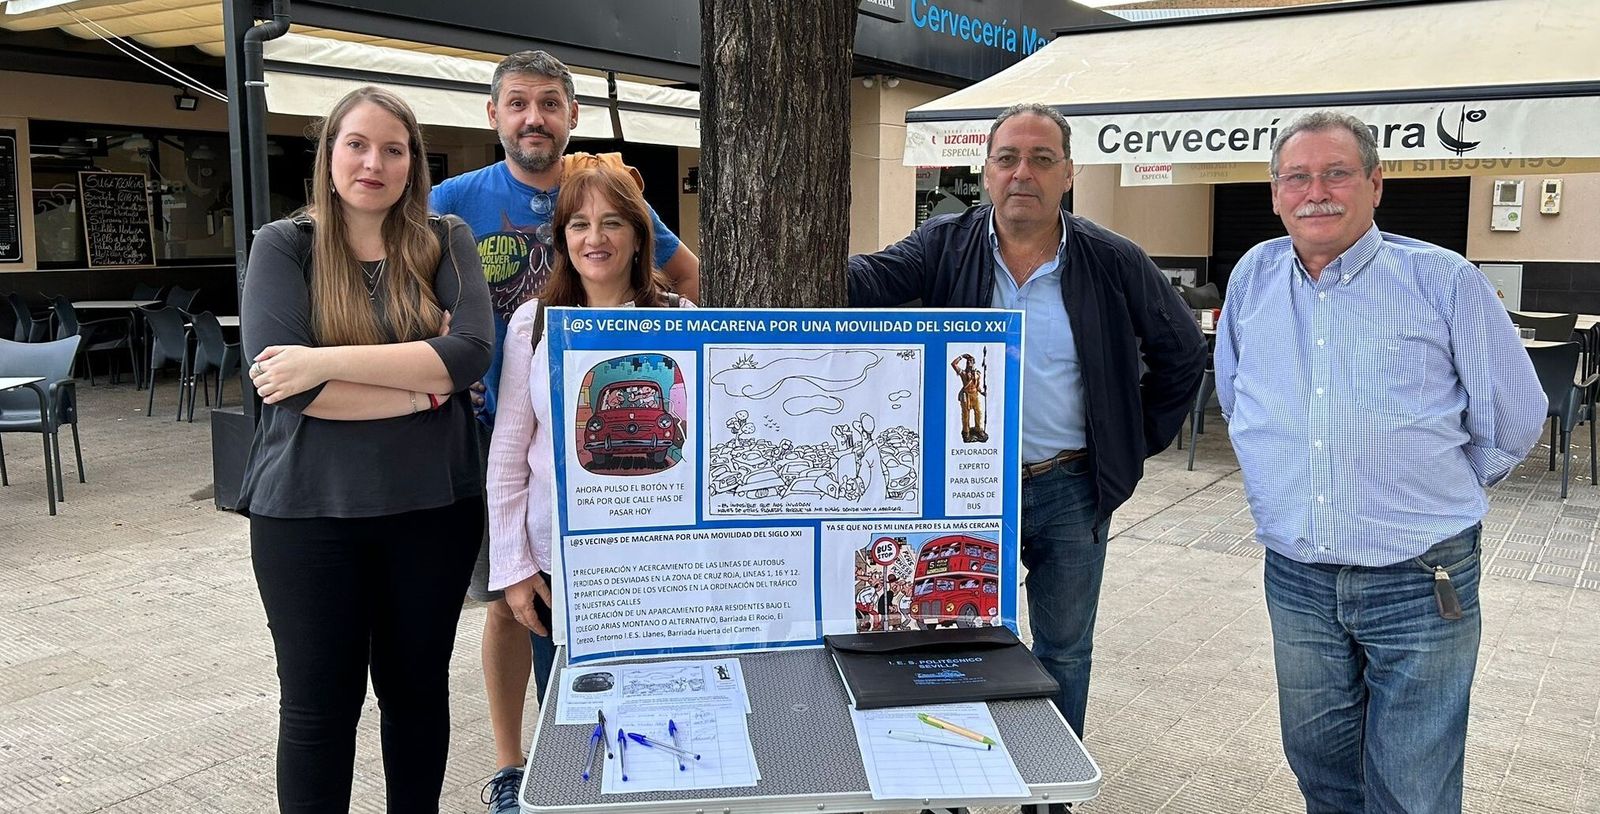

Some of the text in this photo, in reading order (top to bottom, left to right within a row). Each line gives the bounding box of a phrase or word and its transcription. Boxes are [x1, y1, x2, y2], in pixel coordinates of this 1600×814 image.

[911, 0, 1050, 56] Cervecería Ma
[932, 134, 991, 145] Cuzcamp
[1098, 118, 1425, 153] Cervecerí ra
[942, 148, 980, 157] ESPECIAL
[1134, 164, 1172, 173] Cruzcamp
[477, 235, 518, 257] MEJOR
[481, 255, 510, 264] VOLVER
[482, 261, 520, 282] MPRANO
[564, 319, 1006, 332] L@S VECIN@S DE MACARENA POR UNA MOVILIDAD DEL SIGLO XXI
[576, 486, 602, 494] AHORA
[604, 485, 629, 493] PULSO
[630, 484, 639, 492] EL
[641, 482, 668, 491] BOTÓN
[577, 496, 594, 506] DIRÁ
[597, 497, 613, 505] POR
[614, 496, 631, 505] QUE
[633, 496, 654, 504] CALLE
[609, 507, 652, 516] PASAR HOY
[585, 536, 619, 546] VECIN@S
[632, 534, 674, 542] MACARENA
[676, 533, 691, 541] POR
[711, 531, 752, 539] MOVILIDAD
[768, 530, 789, 538] SIGLO
[877, 543, 893, 554] BUS
[877, 552, 893, 560] STOP
[580, 565, 631, 576] RECUPERACIÓN
[639, 562, 693, 572] ACERCAMIENTO
[706, 561, 718, 569] LAS
[719, 560, 742, 568] LINEAS
[573, 579, 603, 588] PERDIDAS
[611, 576, 650, 585] DESVIADAS
[672, 573, 691, 581] ZONA
[723, 571, 742, 579] ROJA,
[743, 570, 766, 578] LINEAS
[580, 588, 631, 598] PARTICIPACIÓN
[643, 586, 656, 594] LOS
[658, 585, 688, 593] VECINOS
[689, 584, 699, 592] EN
[710, 581, 755, 591] ORDENACIÓN
[769, 579, 798, 587] TRÁFICO
[582, 600, 616, 610] NUESTRAS
[616, 598, 641, 607] CALLES
[581, 613, 589, 621] LA
[589, 610, 624, 620] CREACIÓN
[625, 609, 634, 617] DE
[648, 606, 704, 615] APARCAMIENTO
[705, 605, 723, 613] PARA
[725, 602, 765, 611] RESIDENTES
[576, 623, 600, 633] COLEGIO
[600, 621, 621, 630] ARIAS
[622, 619, 660, 628] MONTANO
[661, 618, 667, 626] O
[668, 616, 718, 626] ALTERNATIVO,
[720, 613, 747, 623] Barriada
[777, 612, 784, 620] El
[596, 633, 623, 642] Entorno
[642, 630, 666, 639] Llanes,
[667, 629, 696, 637] Barriada
[698, 627, 721, 635] Huerta
